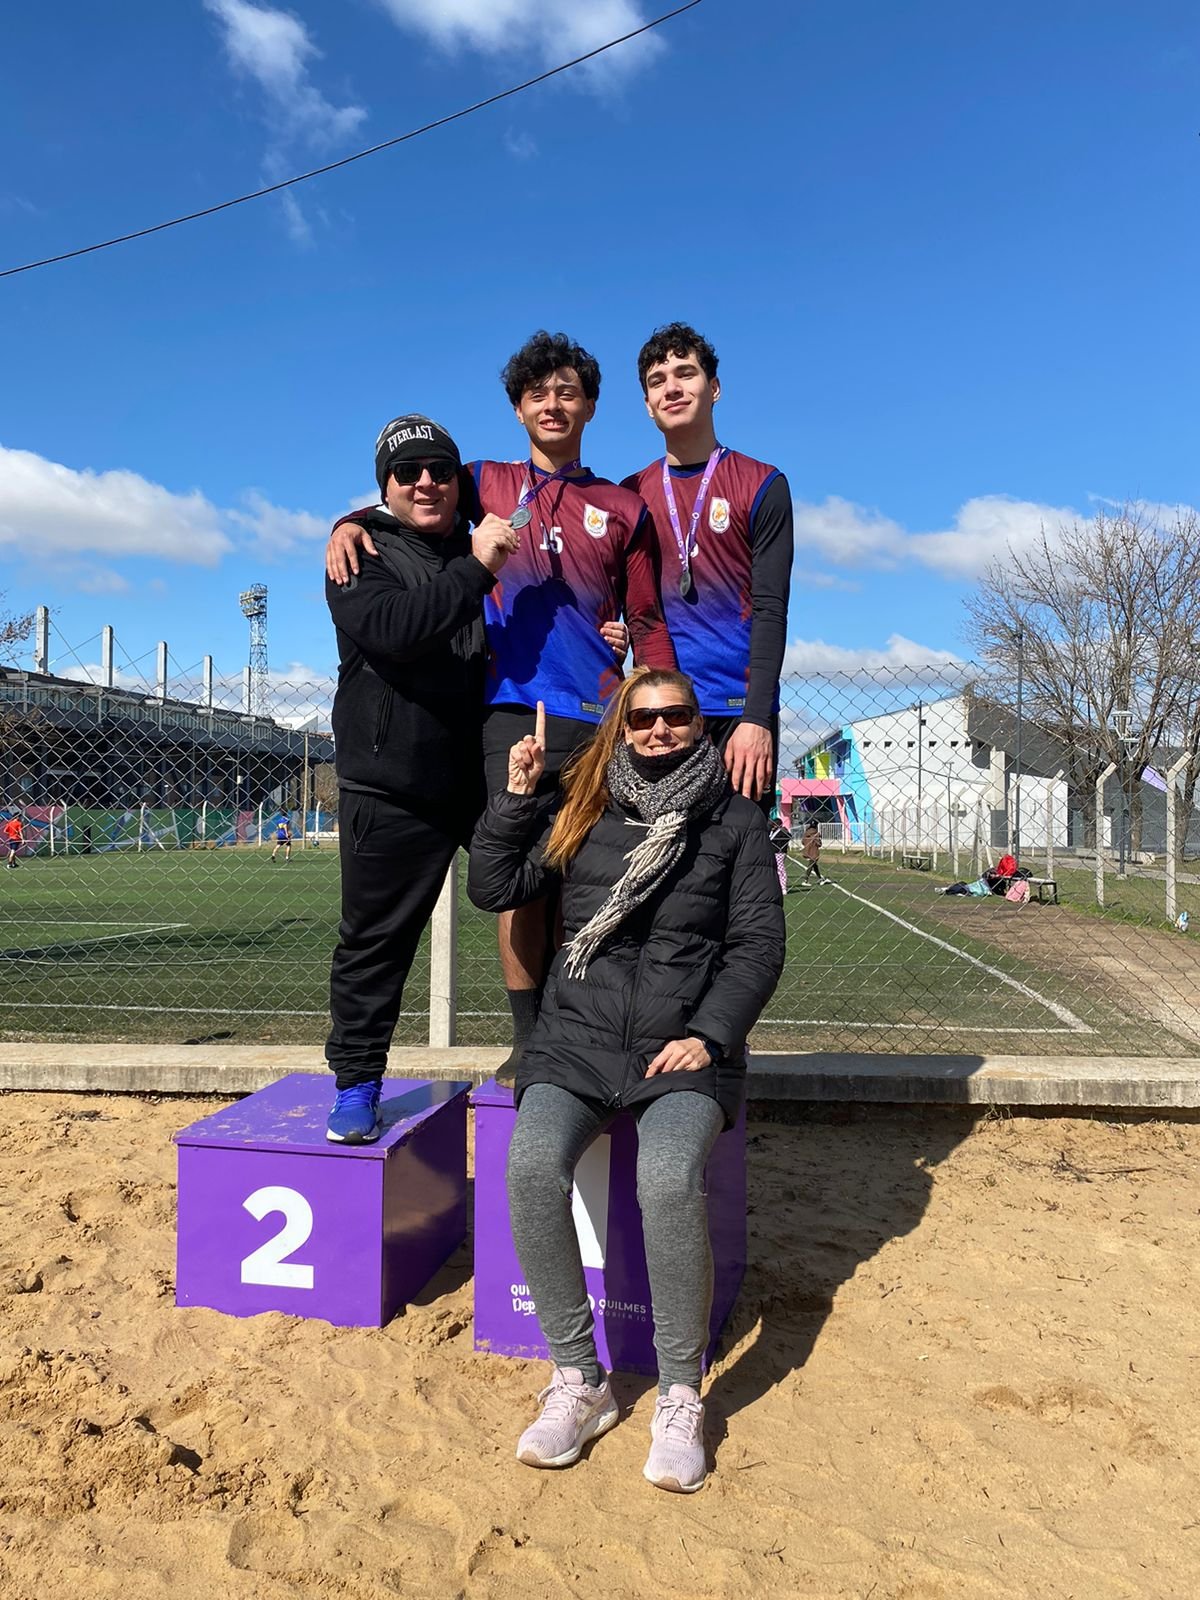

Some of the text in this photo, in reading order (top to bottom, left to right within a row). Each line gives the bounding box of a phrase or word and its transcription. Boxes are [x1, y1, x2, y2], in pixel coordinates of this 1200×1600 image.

[387, 425, 435, 452] EVERLAST
[539, 521, 563, 554] 15
[241, 1185, 314, 1289] 2
[598, 1298, 647, 1314] QUILMES
